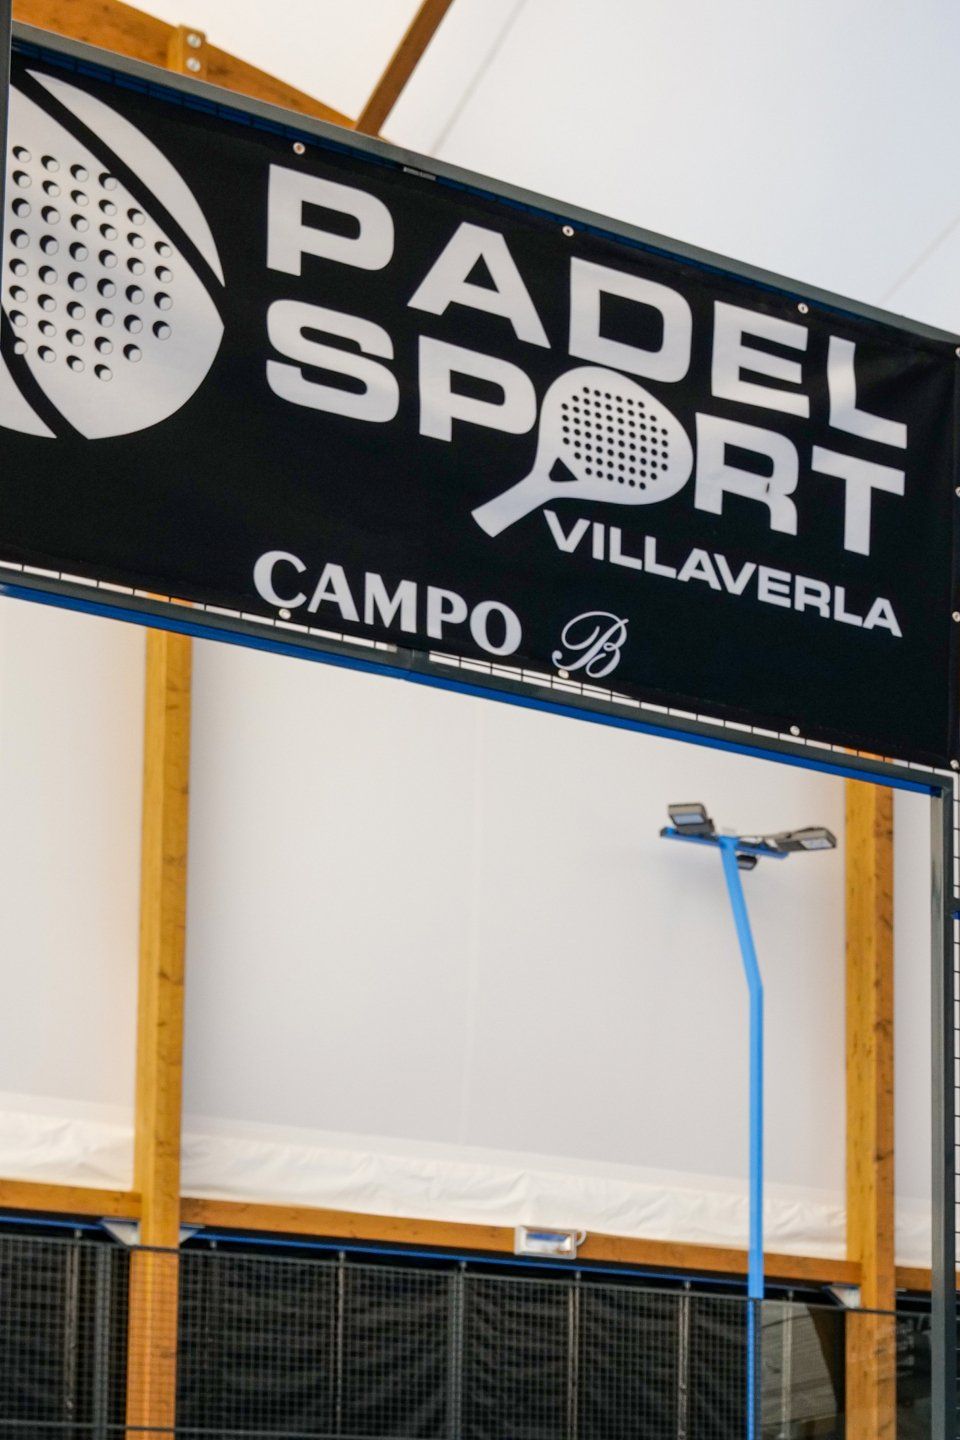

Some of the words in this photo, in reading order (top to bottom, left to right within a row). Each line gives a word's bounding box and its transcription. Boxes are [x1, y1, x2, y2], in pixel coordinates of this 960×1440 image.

[265, 163, 909, 450] PADEL
[265, 298, 907, 556] SPORT
[252, 550, 522, 657] CAMPO
[542, 509, 904, 638] VILLAVERLA
